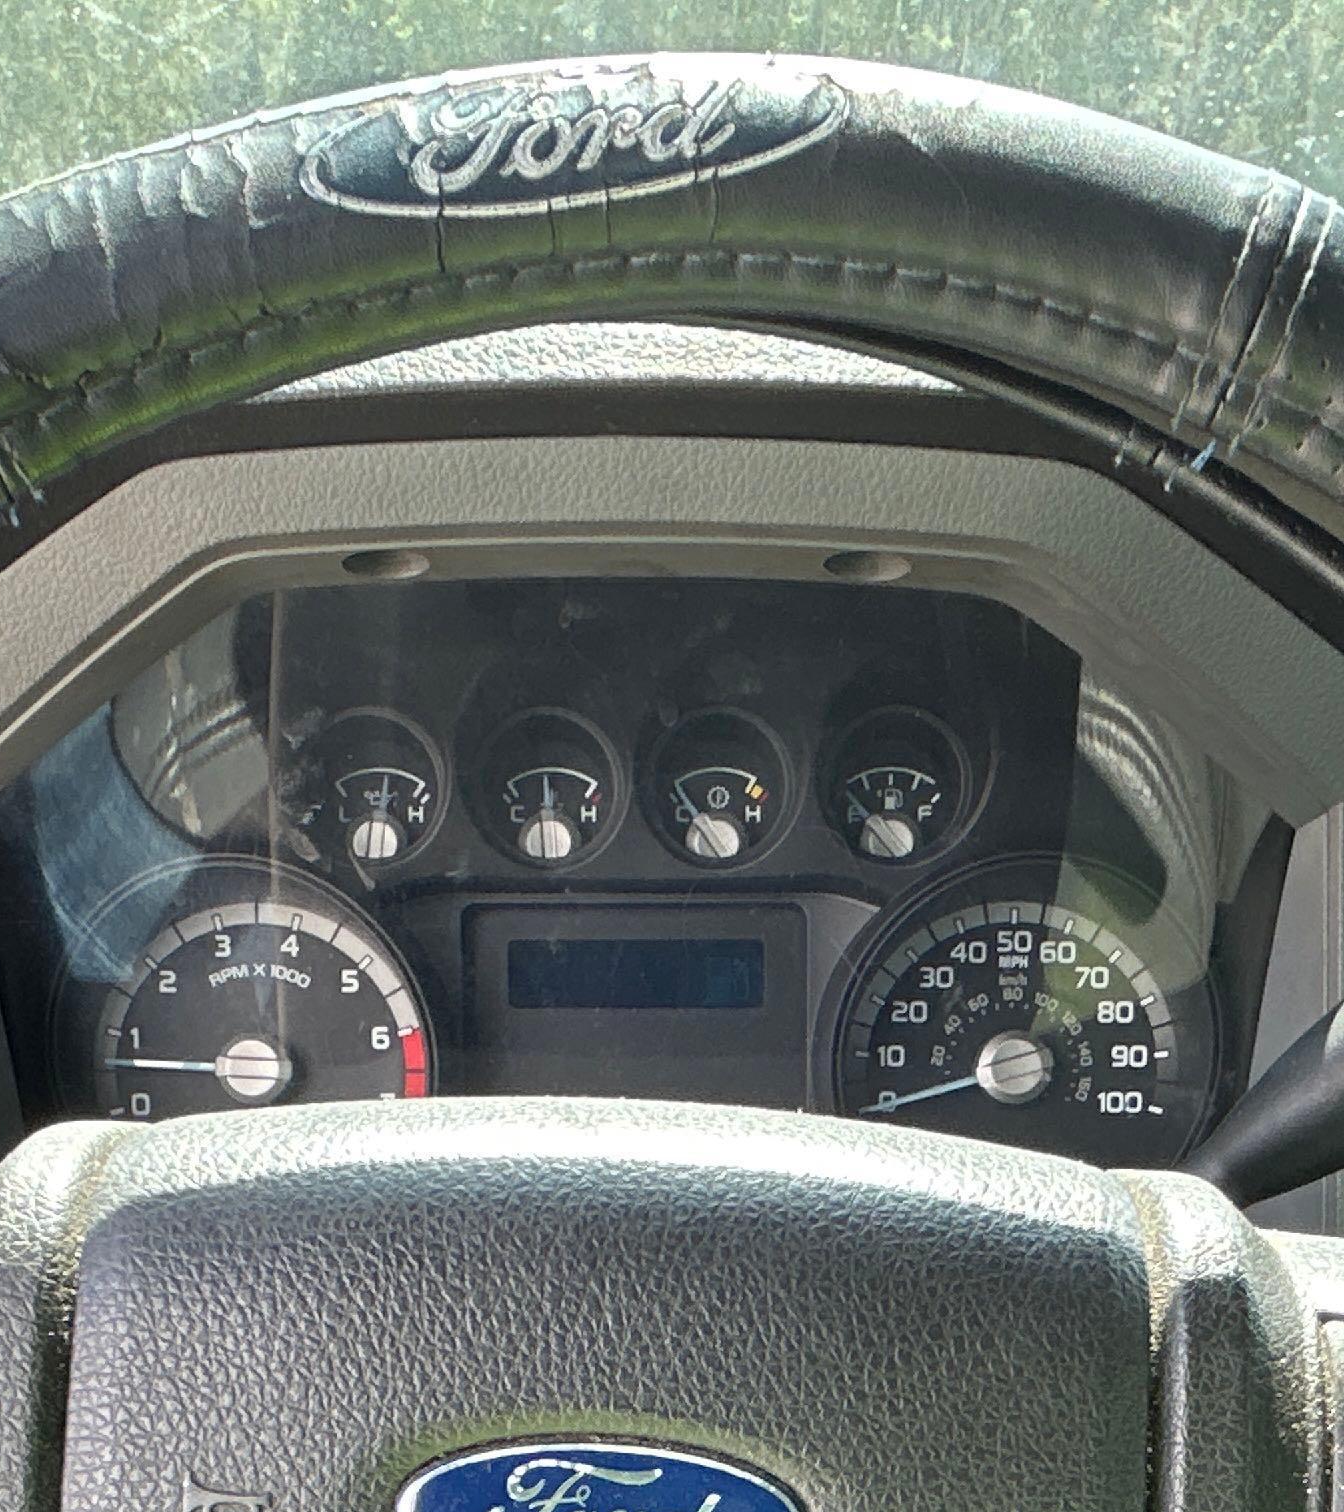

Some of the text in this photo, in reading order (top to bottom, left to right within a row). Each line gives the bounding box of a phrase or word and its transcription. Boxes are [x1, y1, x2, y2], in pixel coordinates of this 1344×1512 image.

[411, 66, 742, 195] Ford
[338, 805, 353, 823] L
[408, 805, 424, 824] H
[510, 805, 526, 823] C
[580, 805, 598, 824] H
[745, 805, 762, 823] H
[917, 804, 933, 822] F
[214, 934, 232, 958] 3
[280, 934, 300, 958] 4
[950, 941, 988, 964] 40
[996, 930, 1033, 953] 50
[1040, 941, 1077, 964] 60
[998, 955, 1029, 969] MPH
[158, 970, 177, 993] 2
[208, 963, 312, 988] RPM X 1000
[340, 969, 360, 993] 5
[919, 966, 954, 988] 30
[1074, 966, 1110, 989] 70
[891, 1000, 928, 1024] 20
[1034, 992, 1060, 1012] 100
[1097, 1000, 1134, 1024] 80
[129, 1027, 140, 1050] 1
[371, 1026, 390, 1050] 6
[877, 1044, 906, 1068] 10
[1111, 1044, 1148, 1068] 90
[130, 1092, 151, 1116] 0
[878, 1090, 897, 1112] 0
[1097, 1090, 1143, 1114] 100
